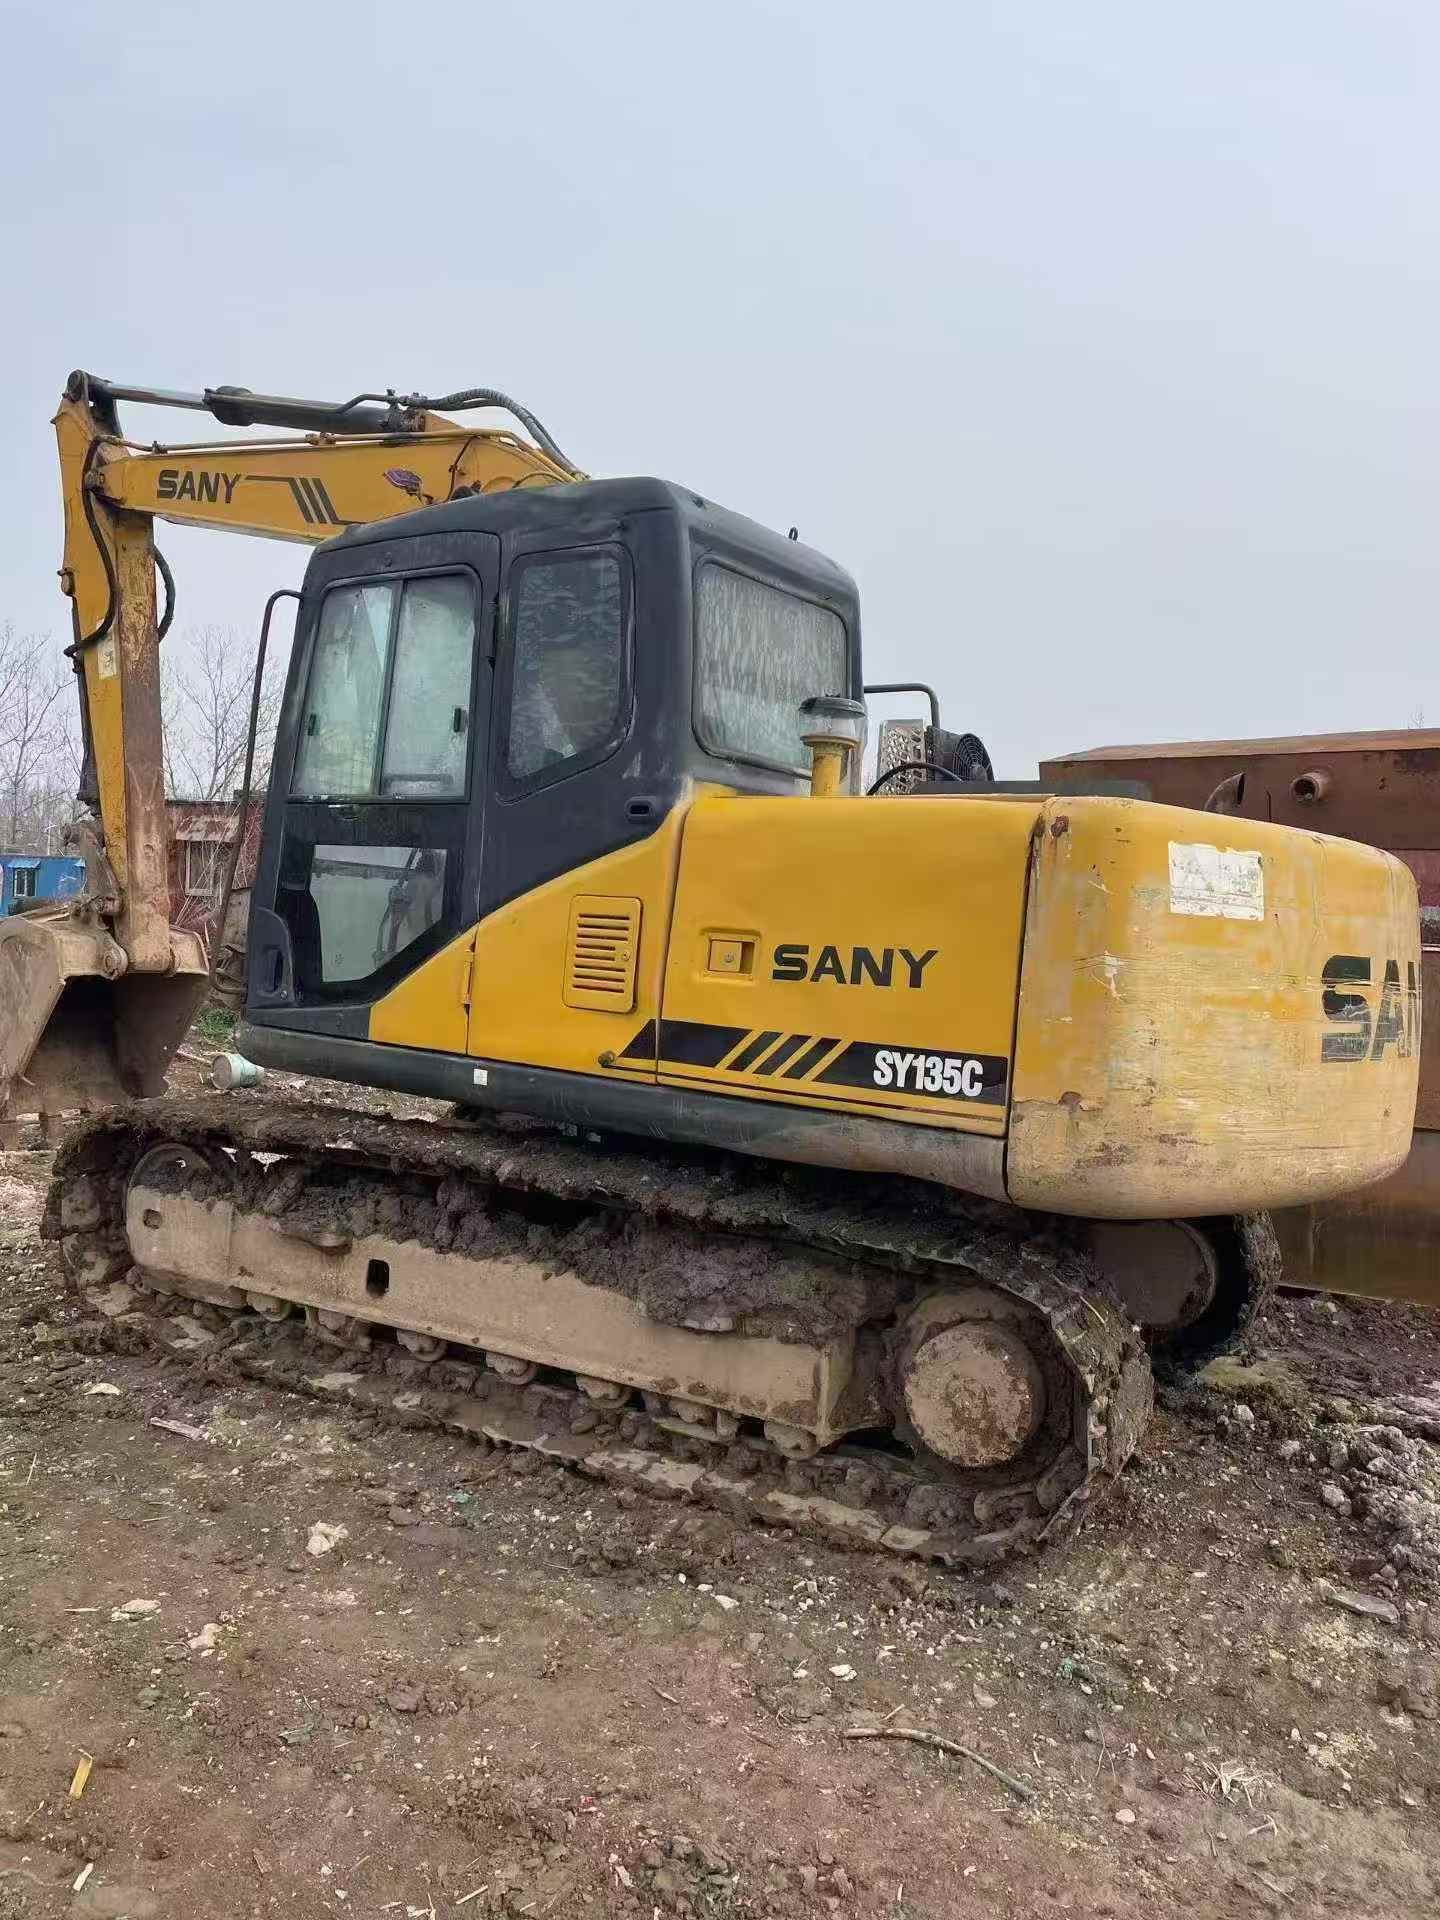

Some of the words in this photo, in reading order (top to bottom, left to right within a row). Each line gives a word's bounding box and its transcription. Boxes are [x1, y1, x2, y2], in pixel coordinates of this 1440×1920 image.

[157, 470, 241, 503] SANY
[772, 944, 938, 988] SANY
[873, 1050, 983, 1097] SY135C
